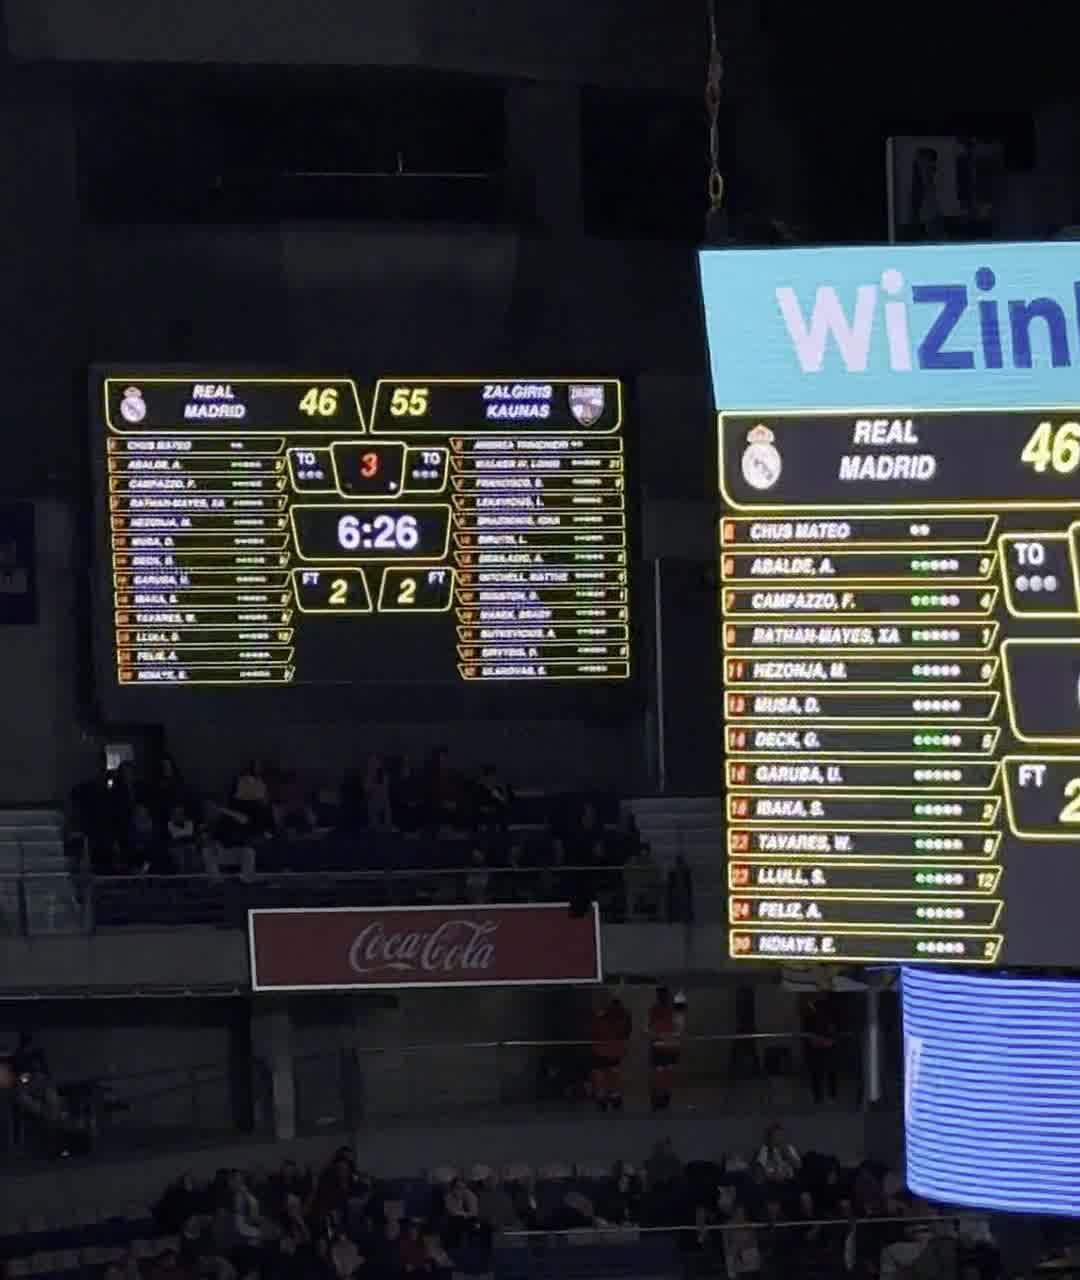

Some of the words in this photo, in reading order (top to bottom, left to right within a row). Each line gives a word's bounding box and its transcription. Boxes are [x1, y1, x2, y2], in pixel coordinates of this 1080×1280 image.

[193, 384, 234, 400] REAL
[298, 388, 337, 417] 46
[390, 388, 429, 416] 55
[184, 403, 246, 419] MADRID
[486, 403, 551, 419] KAUNAS
[853, 419, 919, 445] REAL
[297, 452, 315, 465] TO
[359, 453, 378, 477] 3
[423, 451, 440, 465] TO
[838, 454, 936, 481] MADRID
[337, 514, 418, 550] 6:26
[1014, 543, 1045, 565] TO
[302, 572, 320, 585] FT
[428, 571, 446, 584] FT
[328, 580, 348, 604] 2
[397, 580, 417, 604] 2
[751, 593, 839, 610] CAMPAZZO,
[1018, 764, 1046, 787] FT
[976, 873, 994, 888] 12
